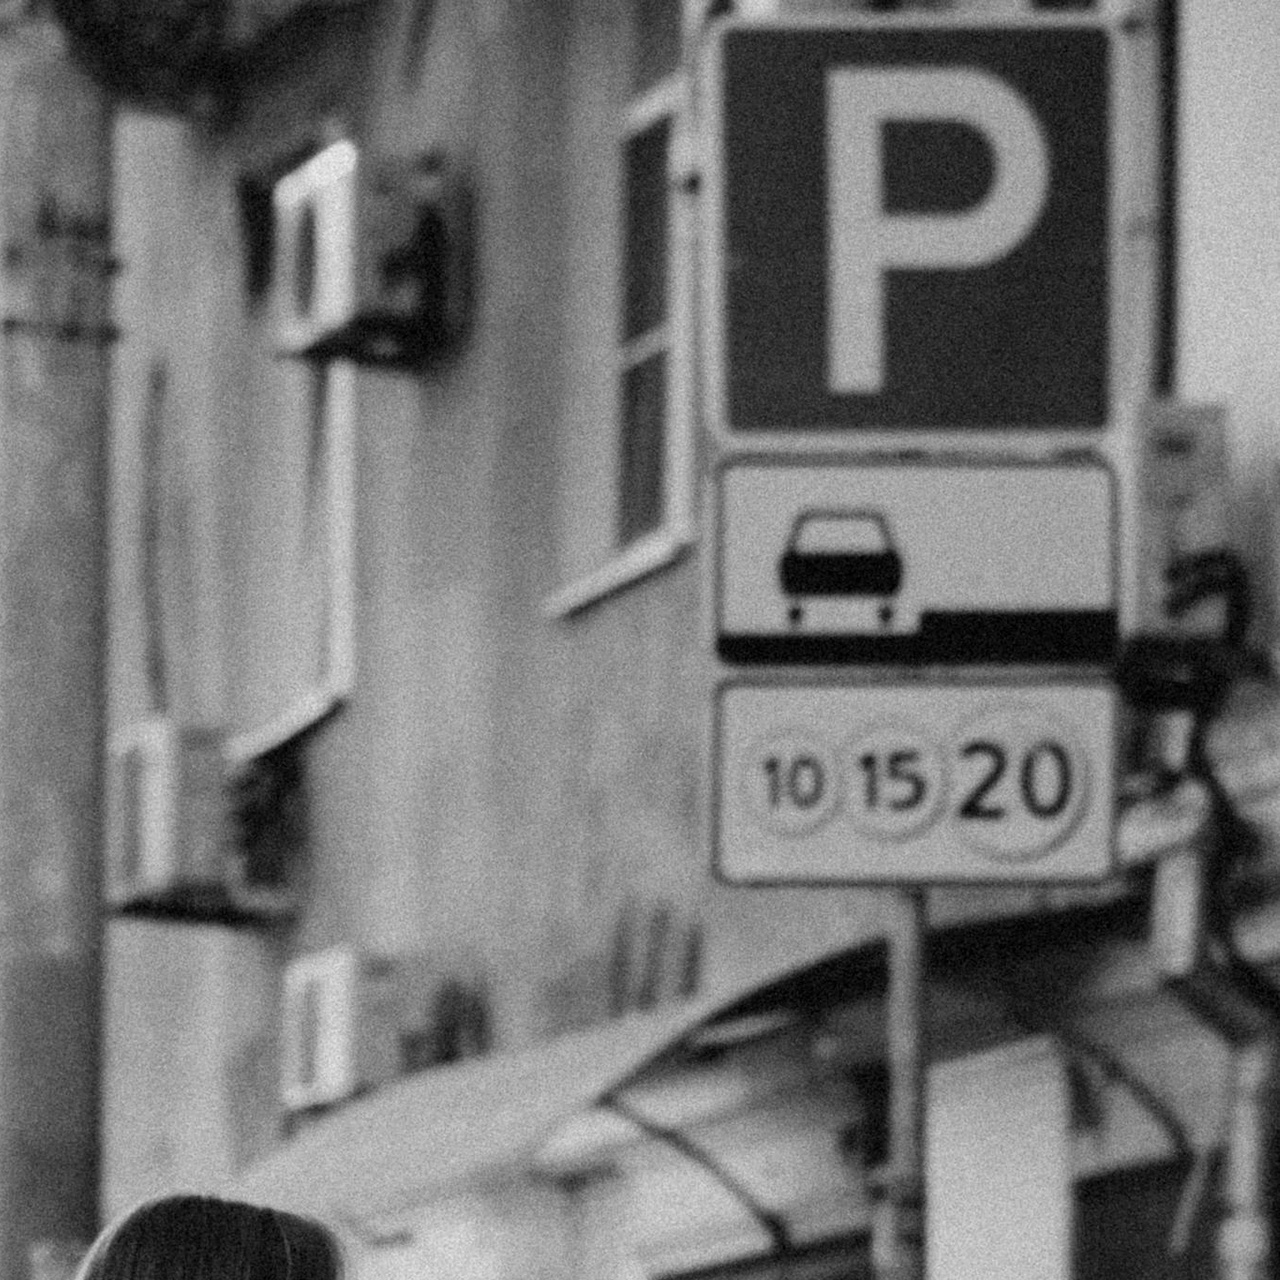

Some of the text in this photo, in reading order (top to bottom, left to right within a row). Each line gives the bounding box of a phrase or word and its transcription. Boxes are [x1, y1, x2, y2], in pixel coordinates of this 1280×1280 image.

[826, 66, 1048, 394] P
[764, 738, 1072, 820] 10 15 20
